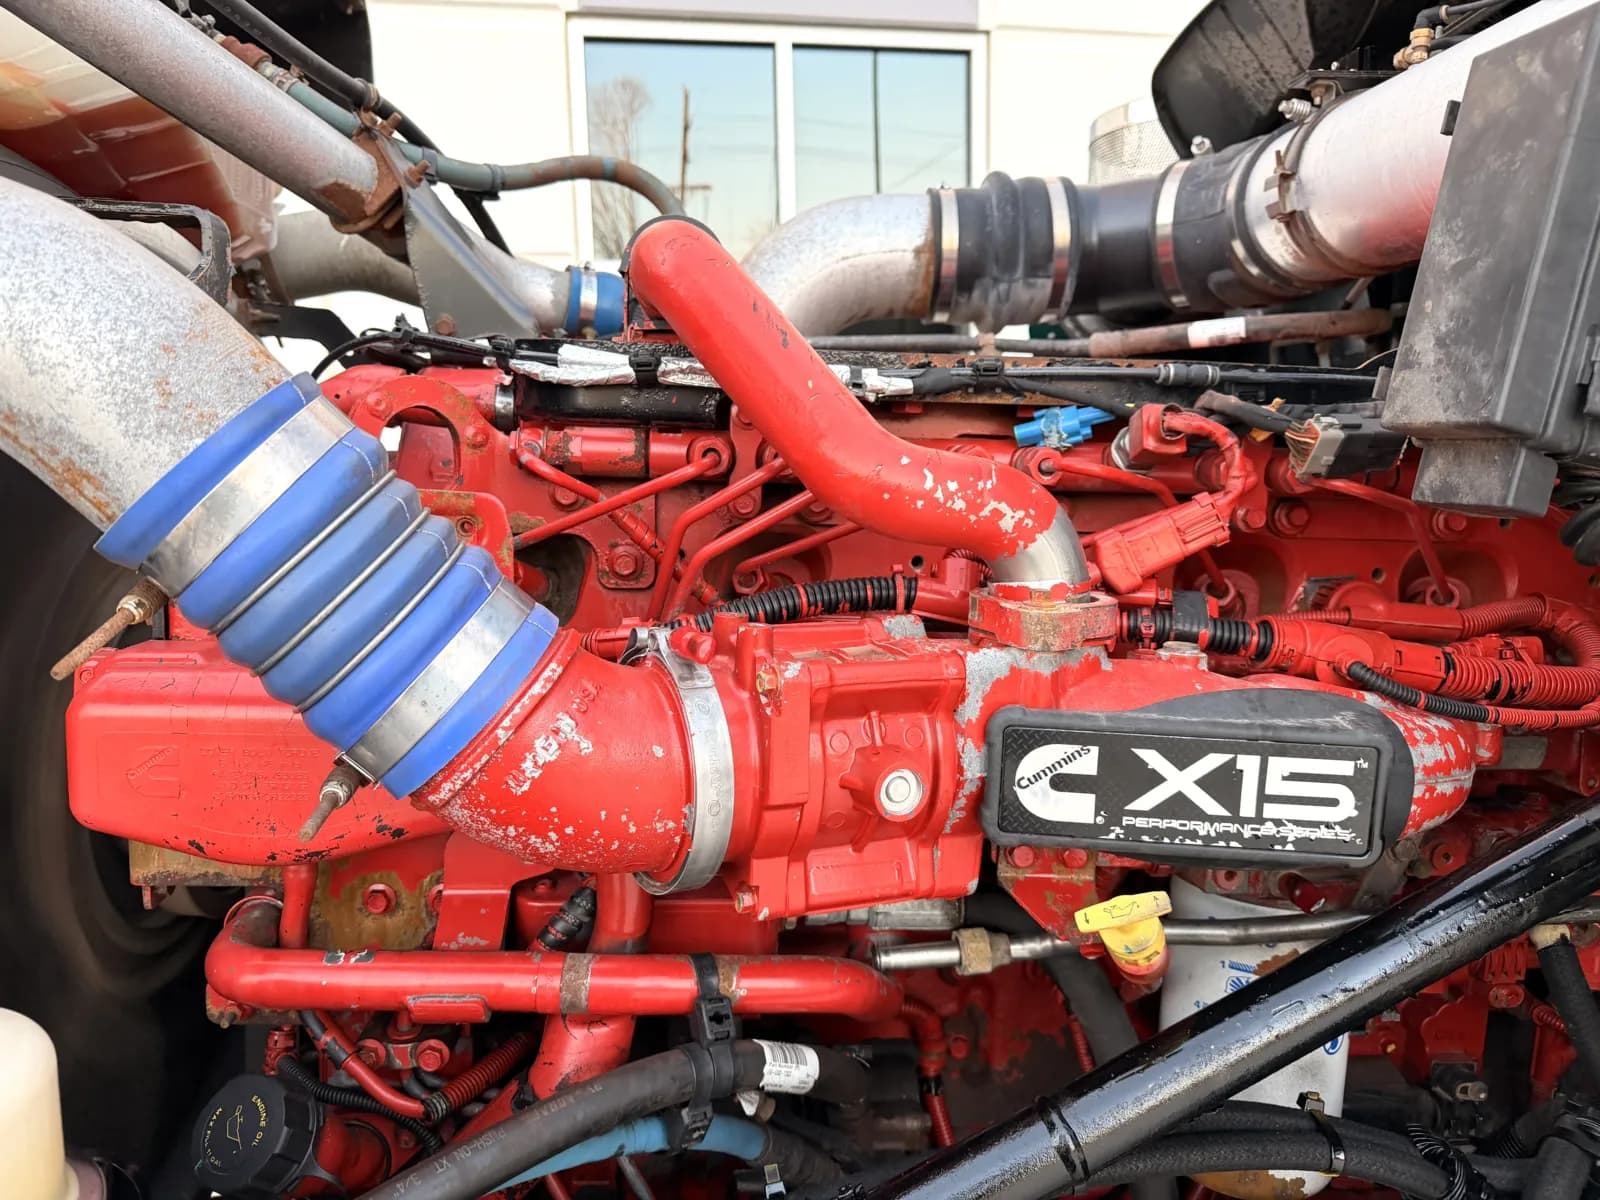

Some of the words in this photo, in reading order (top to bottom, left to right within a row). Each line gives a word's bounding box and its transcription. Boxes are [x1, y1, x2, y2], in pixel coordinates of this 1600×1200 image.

[1015, 744, 1092, 791] Cummins
[1123, 747, 1358, 824] X15
[251, 1095, 267, 1128] ENGINE
[251, 1131, 263, 1147] OIL
[454, 1126, 508, 1162] PUSH-ON
[433, 1156, 452, 1175] XT
